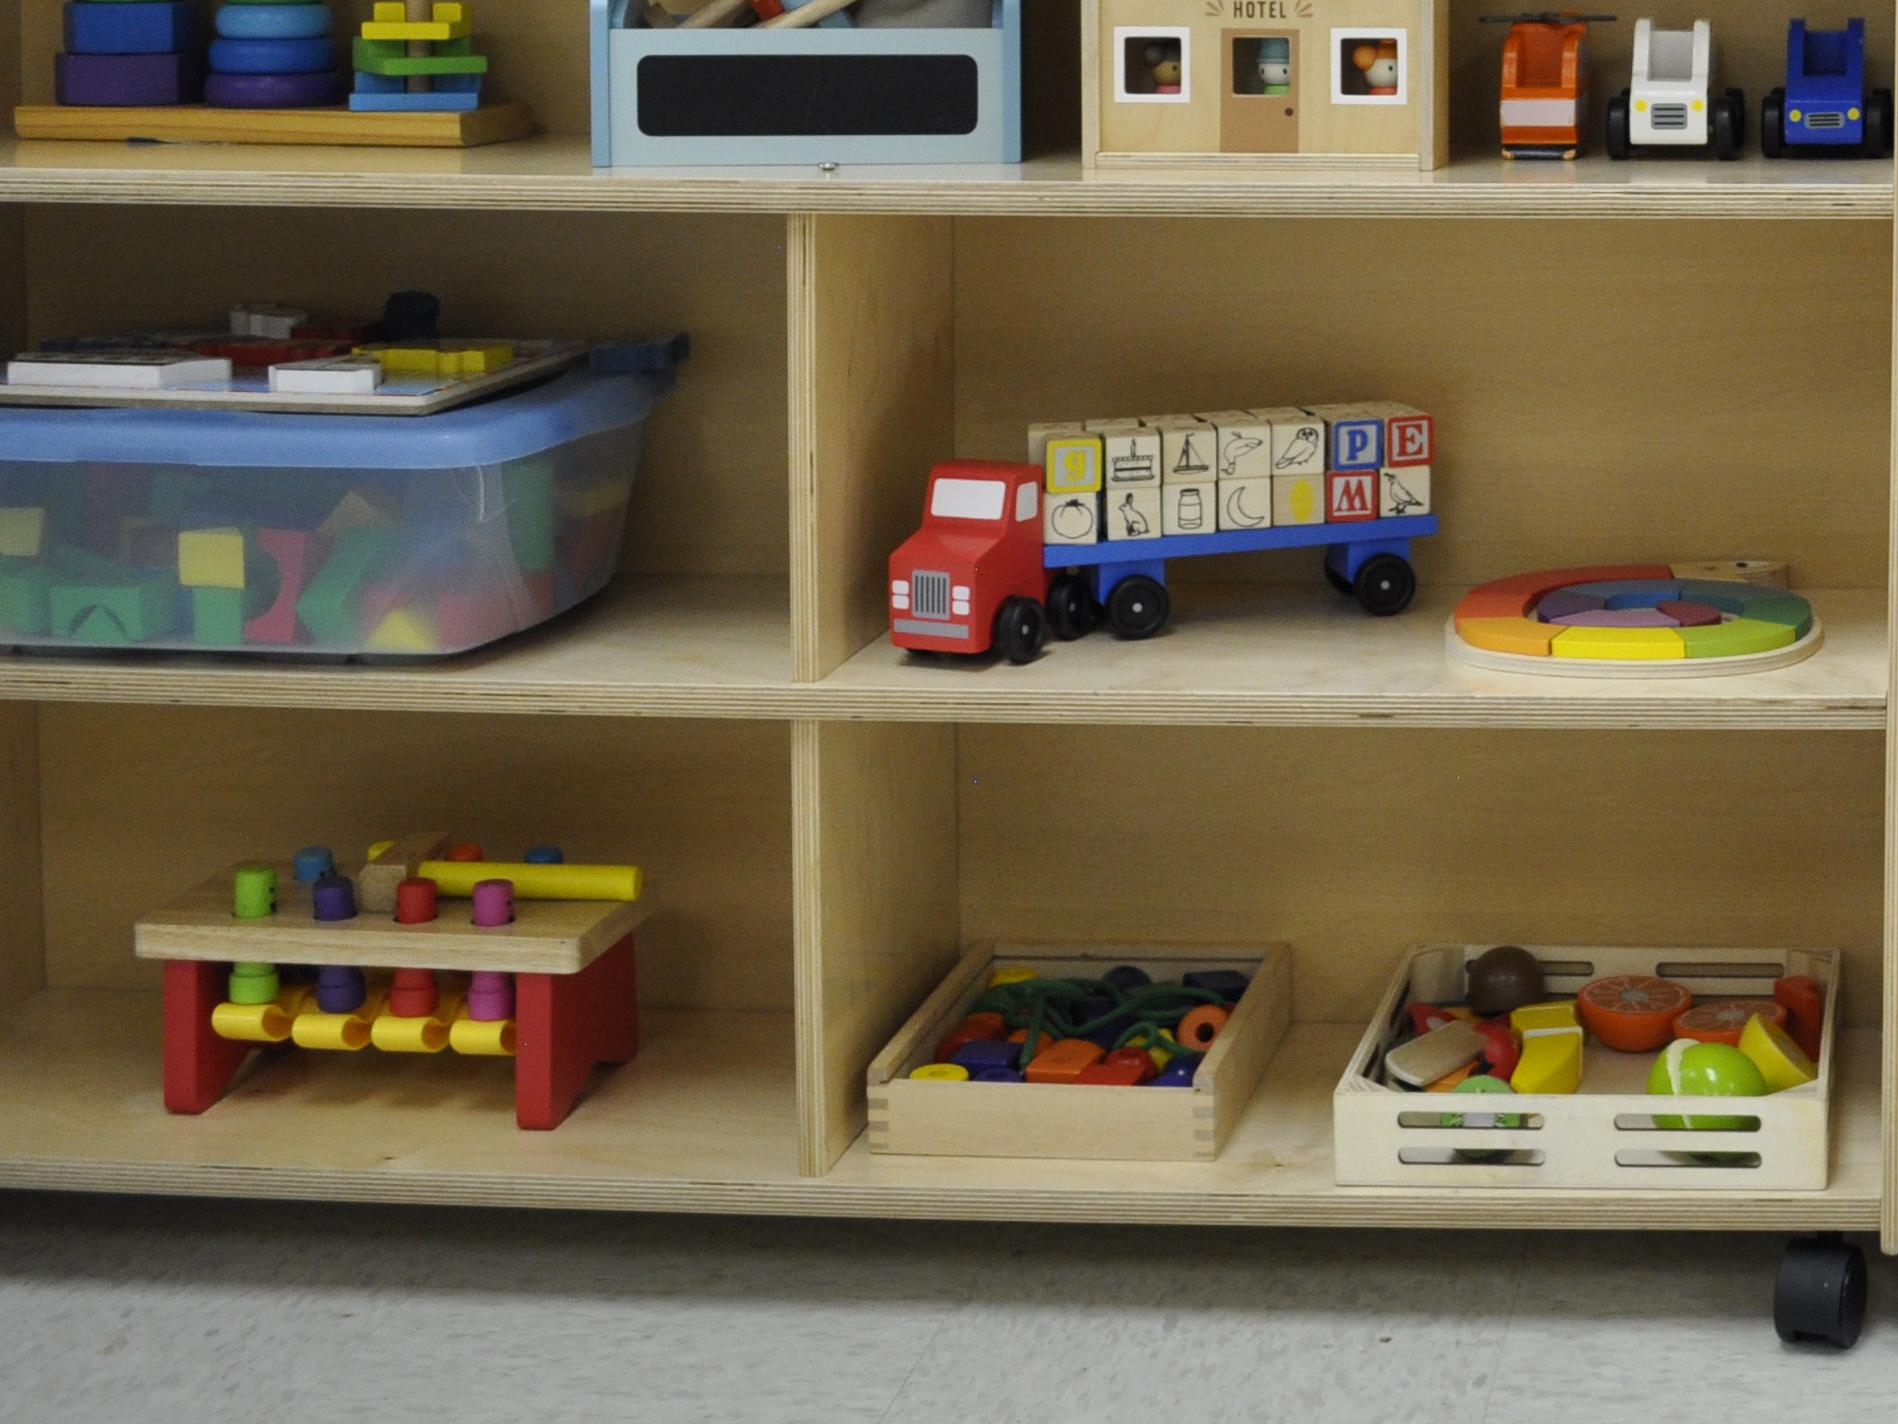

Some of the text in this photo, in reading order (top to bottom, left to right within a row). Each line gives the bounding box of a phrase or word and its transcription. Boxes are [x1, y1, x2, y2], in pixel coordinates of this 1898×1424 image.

[1233, 0, 1286, 18] HOTEL
[1346, 424, 1424, 462] P E
